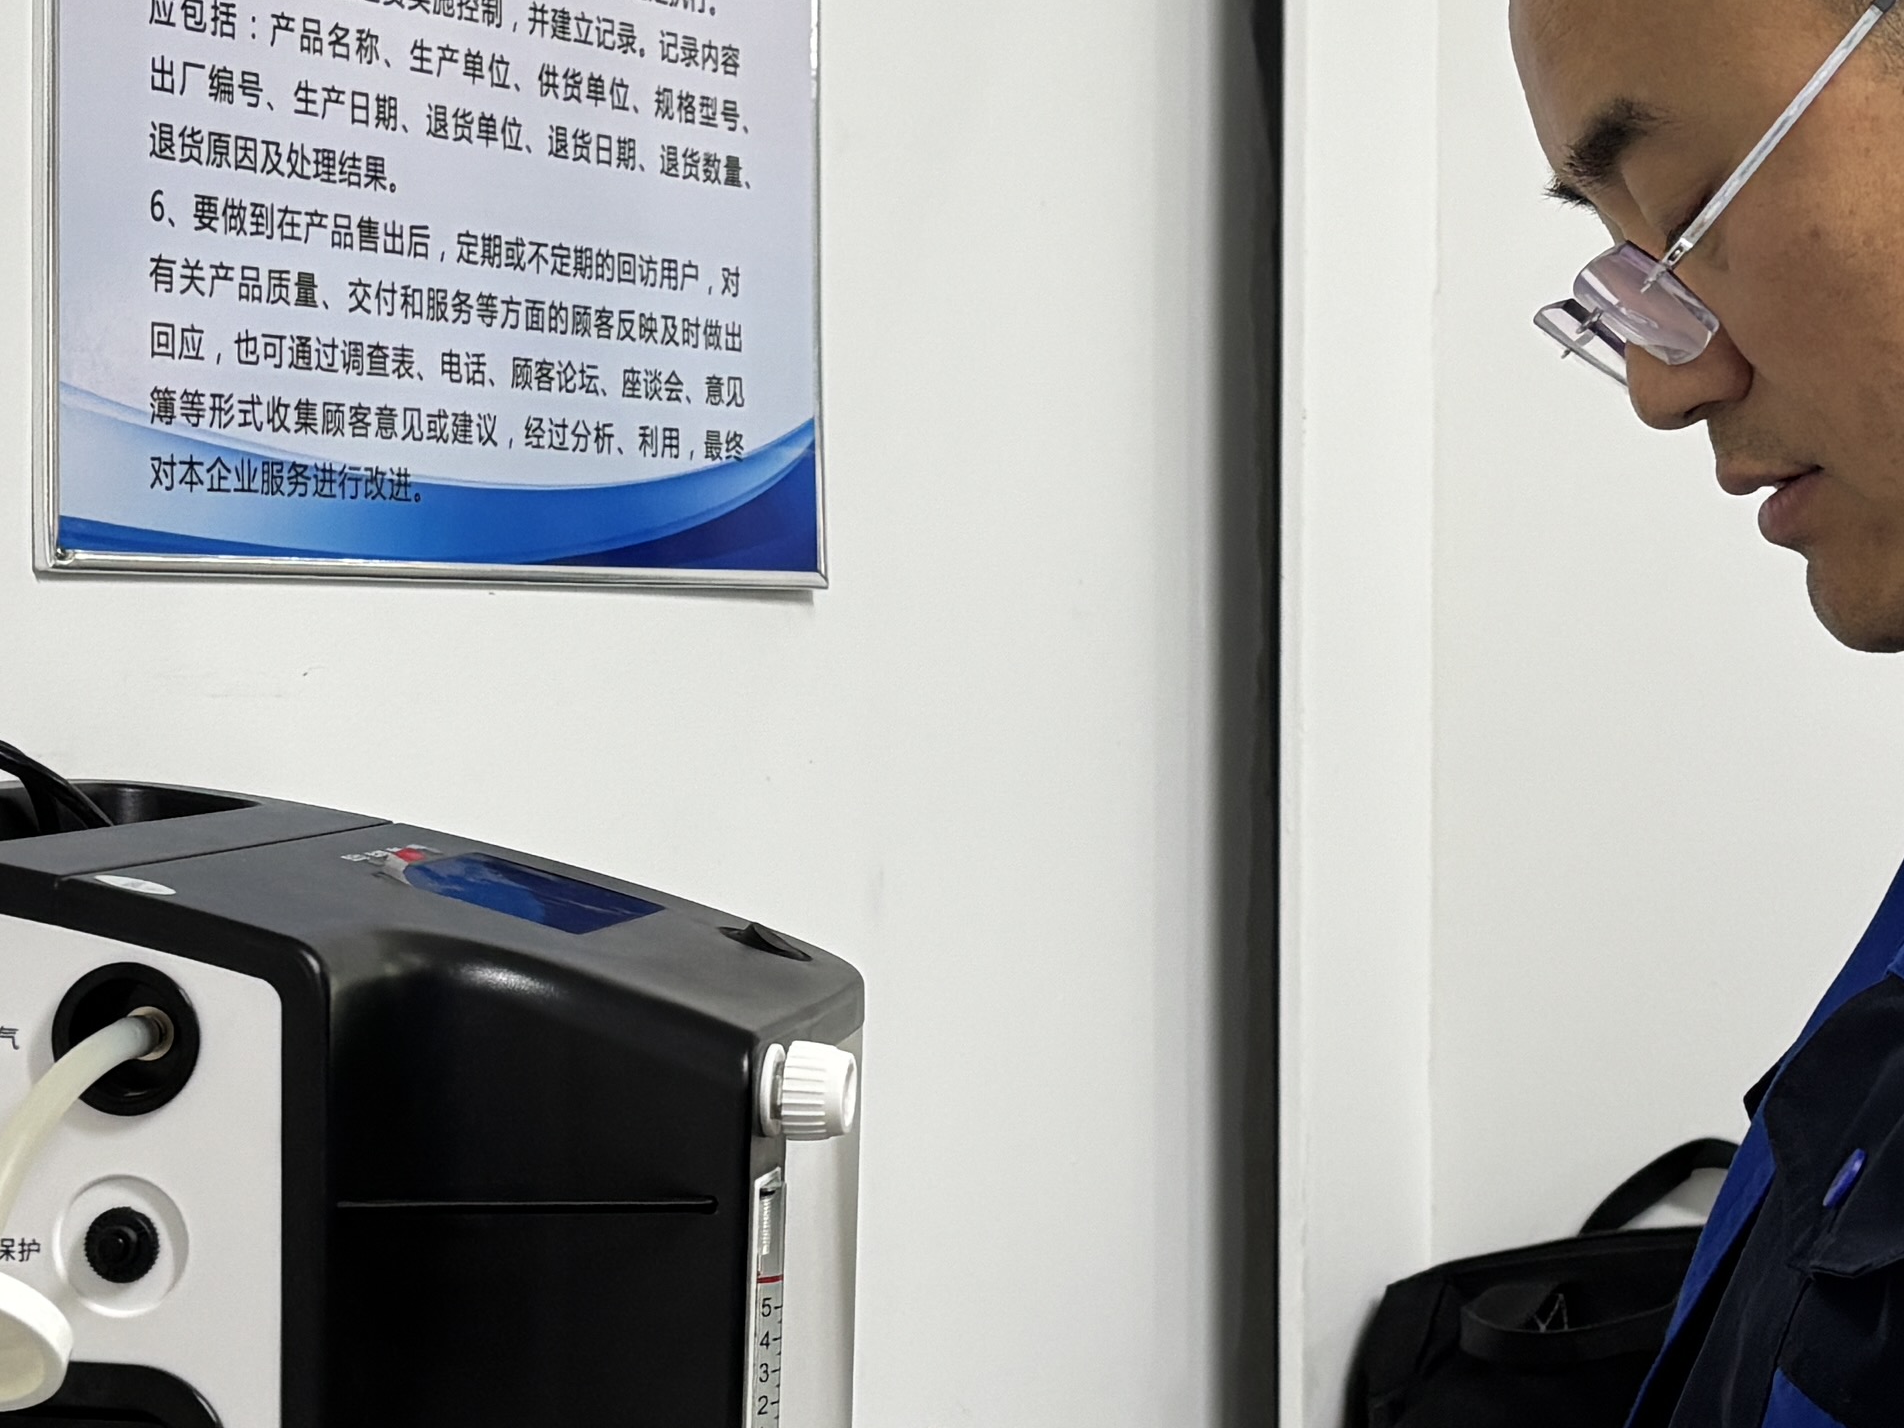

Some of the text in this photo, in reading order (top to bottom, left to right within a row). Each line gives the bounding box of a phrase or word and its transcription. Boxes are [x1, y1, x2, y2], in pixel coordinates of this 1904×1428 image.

[150, 54, 753, 191] 出厂编号、生产日期、退货单位、退货日期、退货数量、
[149, 119, 398, 194] 退货原因及处理结果。
[149, 188, 742, 299] 6、要做到在产品售出后，定期或不定期的回访用户，对
[149, 252, 744, 354] 有关产品质量、交付和服务等方面的顾客反映及时做出
[150, 320, 746, 409] 回应，也可通过调查表、电话、顾客论坛、座谈会、意见
[149, 453, 423, 504] 对本企业服务进行改进。
[761, 1297, 773, 1318] 5
[759, 1330, 771, 1350] 4
[758, 1362, 770, 1383] 3
[756, 1395, 769, 1416] 2
